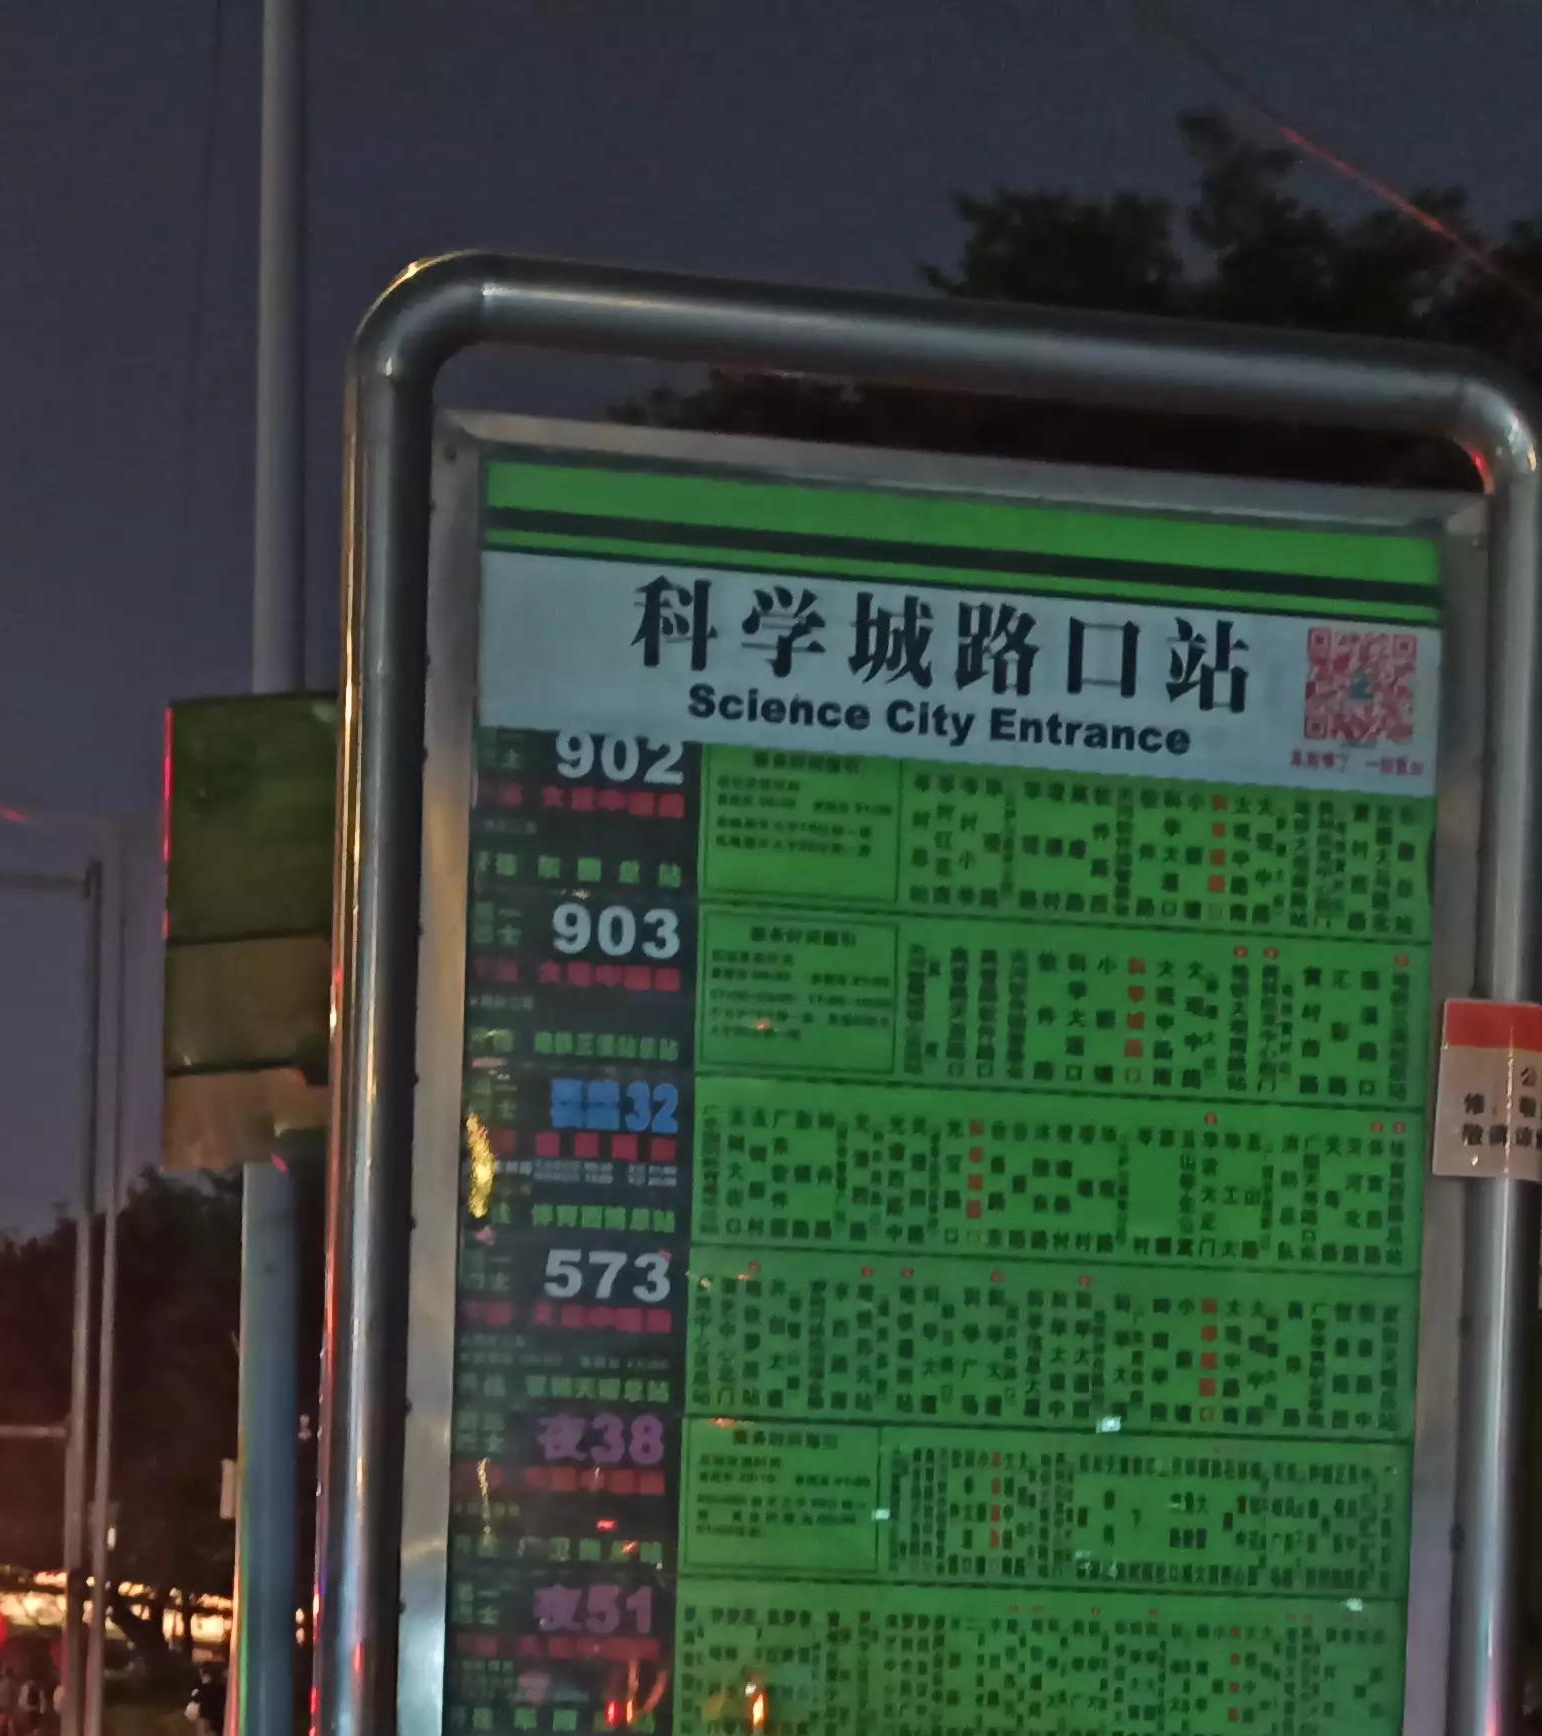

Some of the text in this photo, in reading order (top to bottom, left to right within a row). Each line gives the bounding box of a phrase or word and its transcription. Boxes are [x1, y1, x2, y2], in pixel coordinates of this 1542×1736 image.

[630, 575, 1249, 713] 科学城路口站
[688, 683, 1192, 754] Science City Entrance
[556, 732, 684, 785] 902
[552, 902, 681, 960] 903
[544, 1247, 672, 1303] 573
[536, 1413, 664, 1465] 夜38
